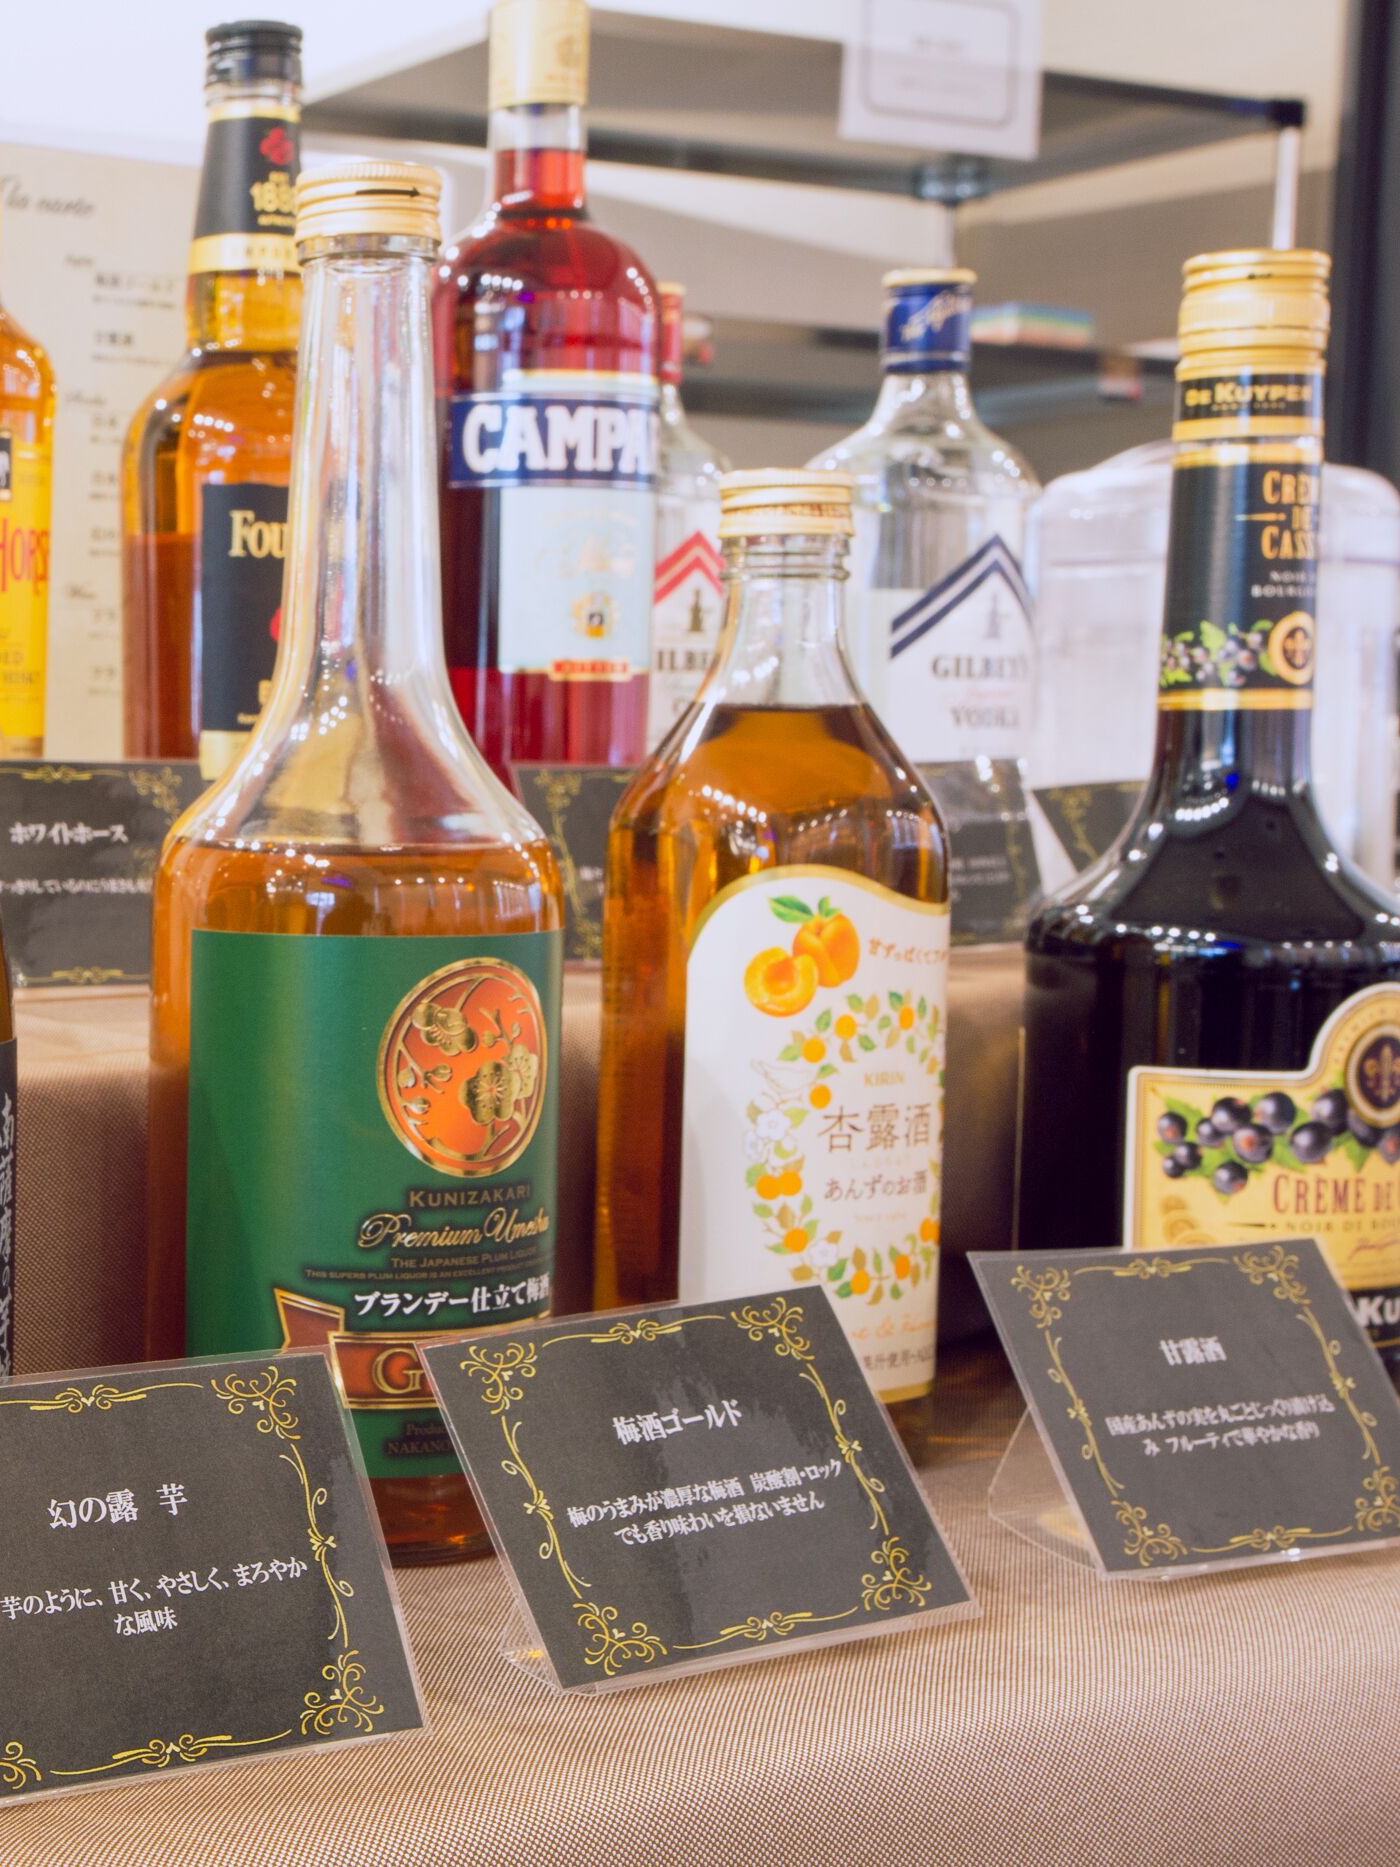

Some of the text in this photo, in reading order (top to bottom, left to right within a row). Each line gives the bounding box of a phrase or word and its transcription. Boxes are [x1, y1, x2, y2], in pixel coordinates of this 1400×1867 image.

[8, 821, 130, 846] ホワイトホース
[863, 1071, 905, 1087] KIRIN
[818, 1101, 932, 1153] 杏露酒
[409, 1184, 531, 1207] KUNIZAKARI
[823, 1170, 928, 1202] あんずのお酒
[1272, 1171, 1394, 1216] CRÈME DE
[358, 1213, 483, 1248] Premium
[306, 1269, 328, 1279] THIS
[329, 1270, 366, 1280] SUPERB
[368, 1271, 393, 1280] PLUM
[395, 1271, 428, 1280] LIQUOR
[430, 1271, 438, 1280] IS
[439, 1270, 452, 1279] AN
[453, 1266, 495, 1278] EXCELLENT
[391, 1256, 417, 1269] THE
[420, 1255, 479, 1269] JAPANESE
[481, 1251, 508, 1264] PLUM
[354, 1274, 550, 1317] ブランデー仕立て梅酒
[612, 1399, 743, 1446] 梅酒ゴールド
[47, 1482, 188, 1529] 幻の露 芋
[567, 1457, 842, 1528] 梅のうまみが濃厚な梅酒 炭酸割・ロック
[614, 1490, 825, 1546] でも香り味わいを損ないません
[113, 1606, 178, 1636] な風味
